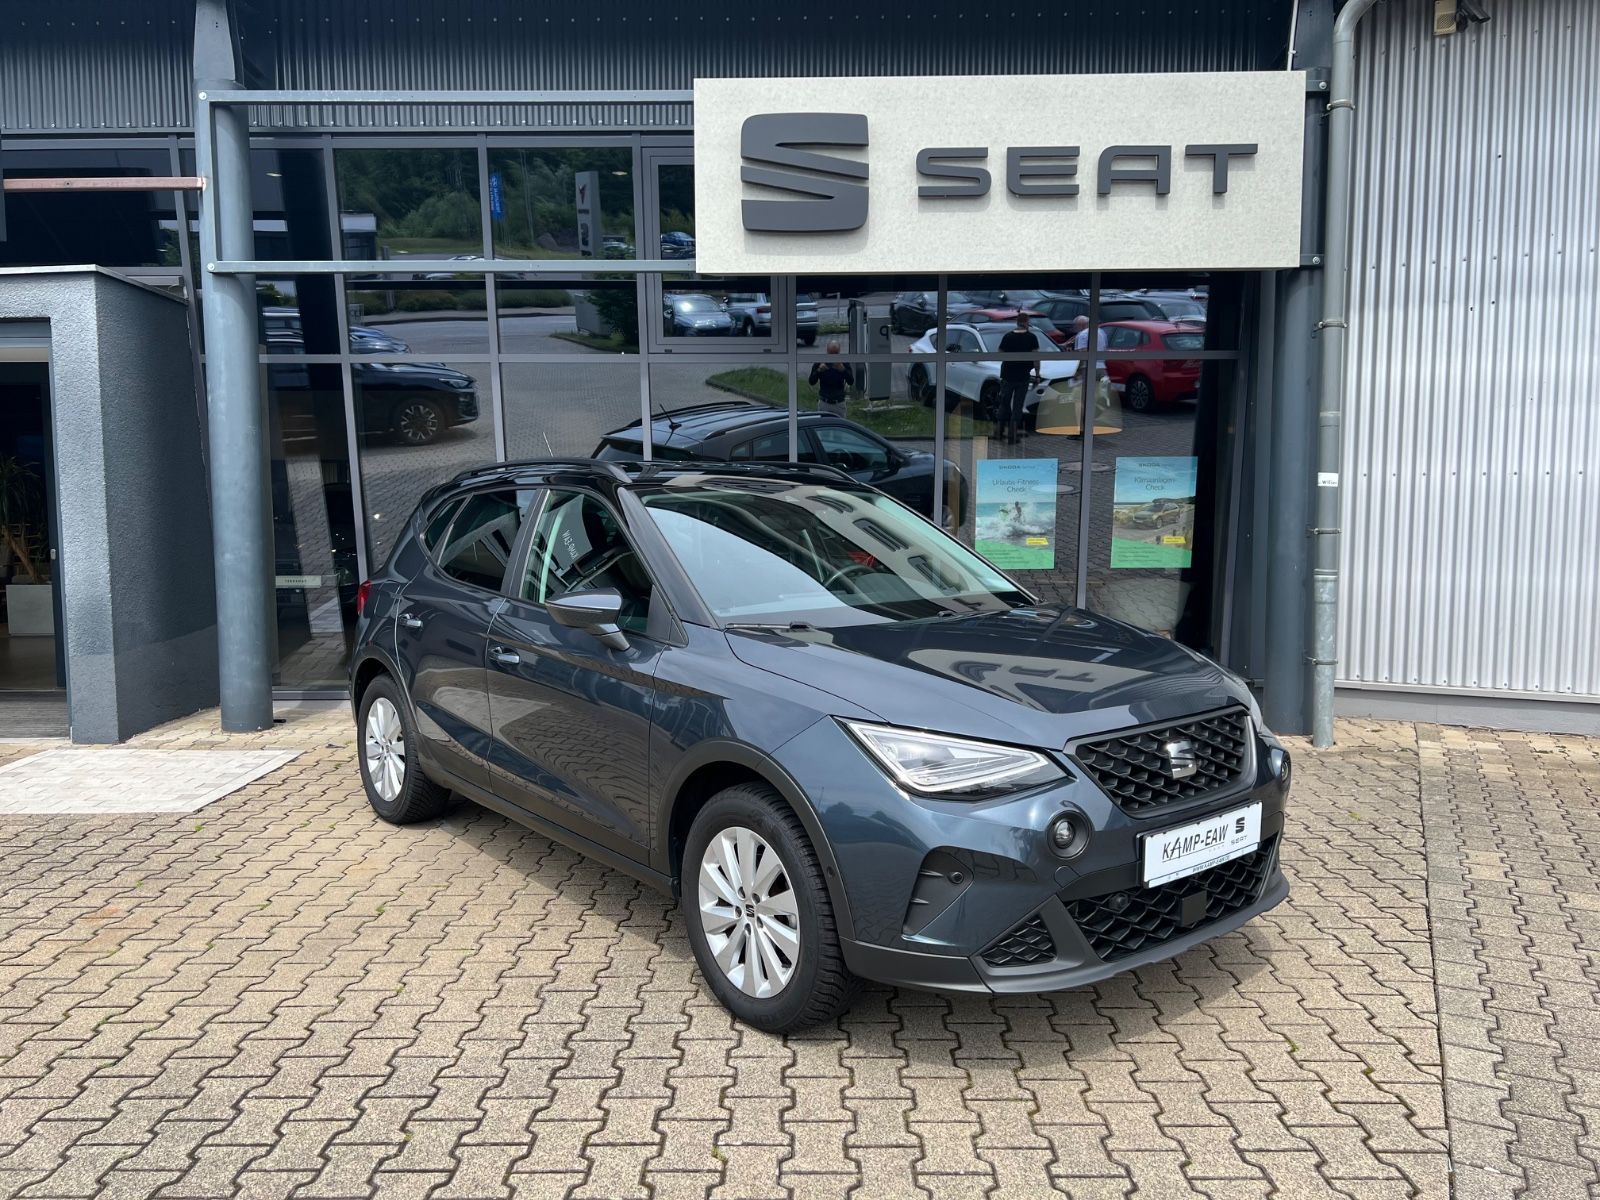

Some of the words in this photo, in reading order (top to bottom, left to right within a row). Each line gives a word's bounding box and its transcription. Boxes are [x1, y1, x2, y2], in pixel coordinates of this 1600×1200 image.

[915, 143, 1259, 198] SEAT
[1162, 823, 1229, 860] KAMP-EAW
[1230, 835, 1248, 846] SEAT
